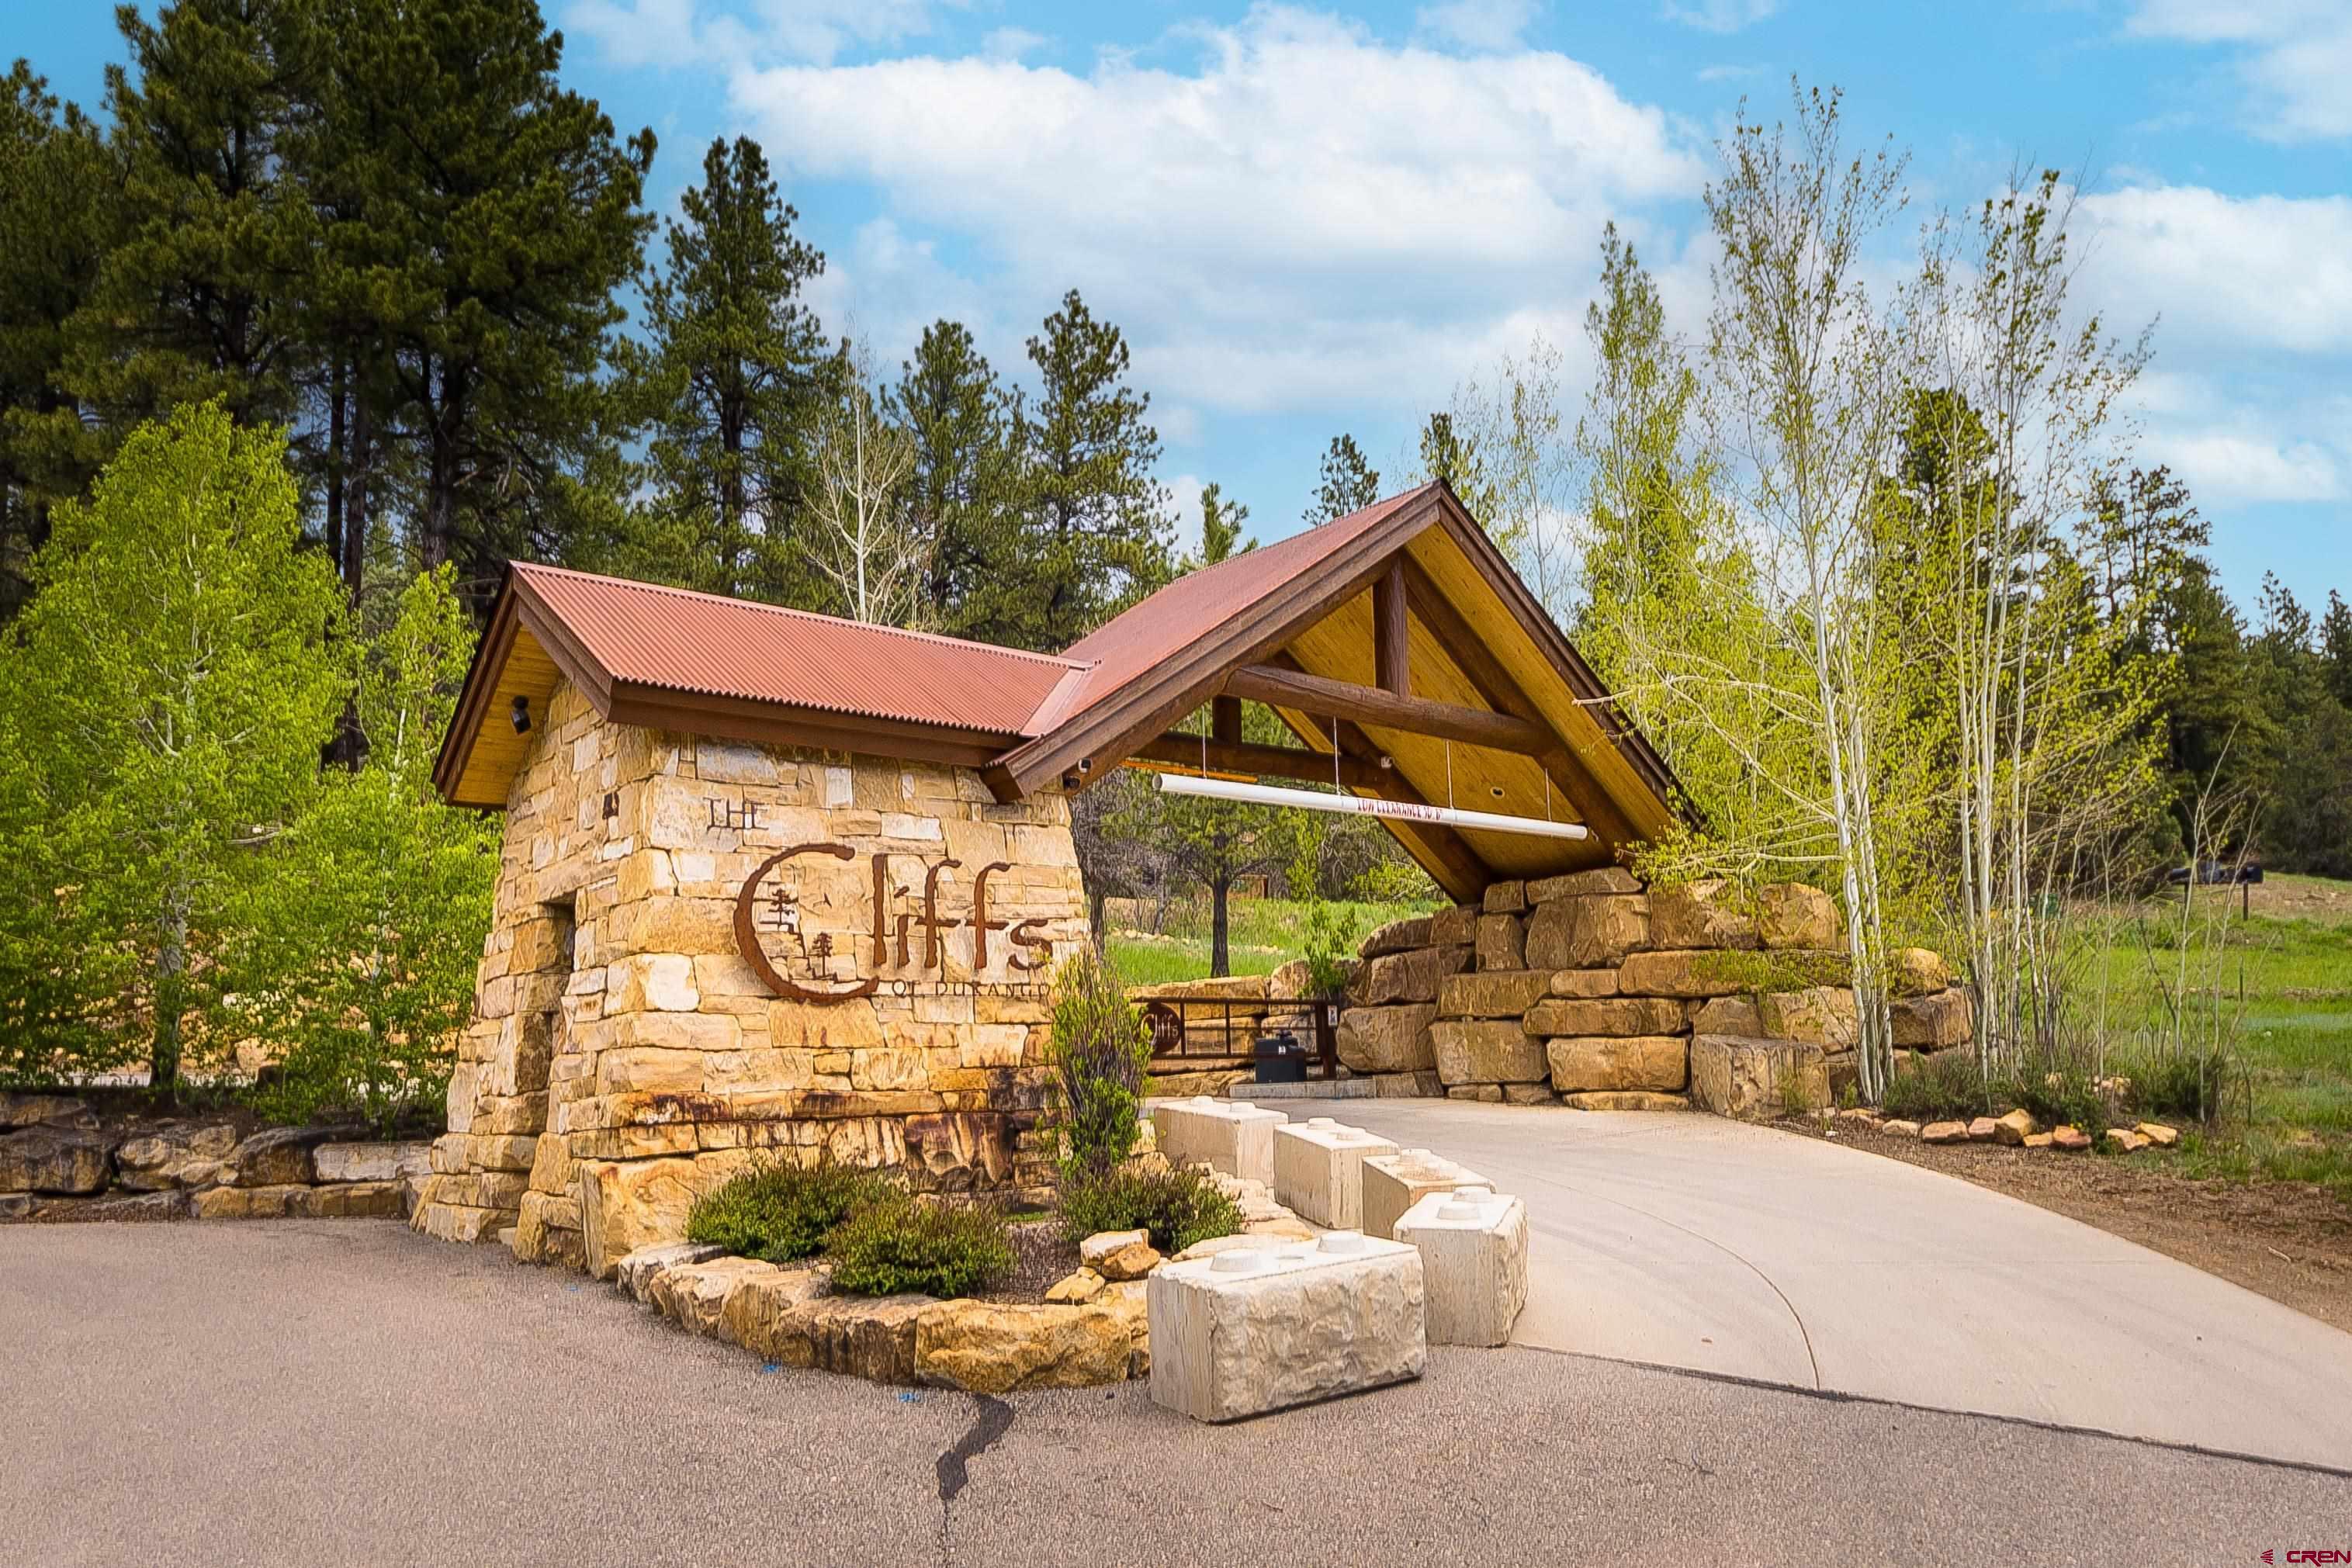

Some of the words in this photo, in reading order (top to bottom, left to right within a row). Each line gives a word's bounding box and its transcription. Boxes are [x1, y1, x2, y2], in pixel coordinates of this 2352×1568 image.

[702, 796, 769, 830] THE
[1357, 799, 1374, 812] LOW
[1377, 801, 1422, 818] CLEARANCE
[733, 843, 1054, 1003] Cliffs
[936, 980, 1051, 997] DURANGO
